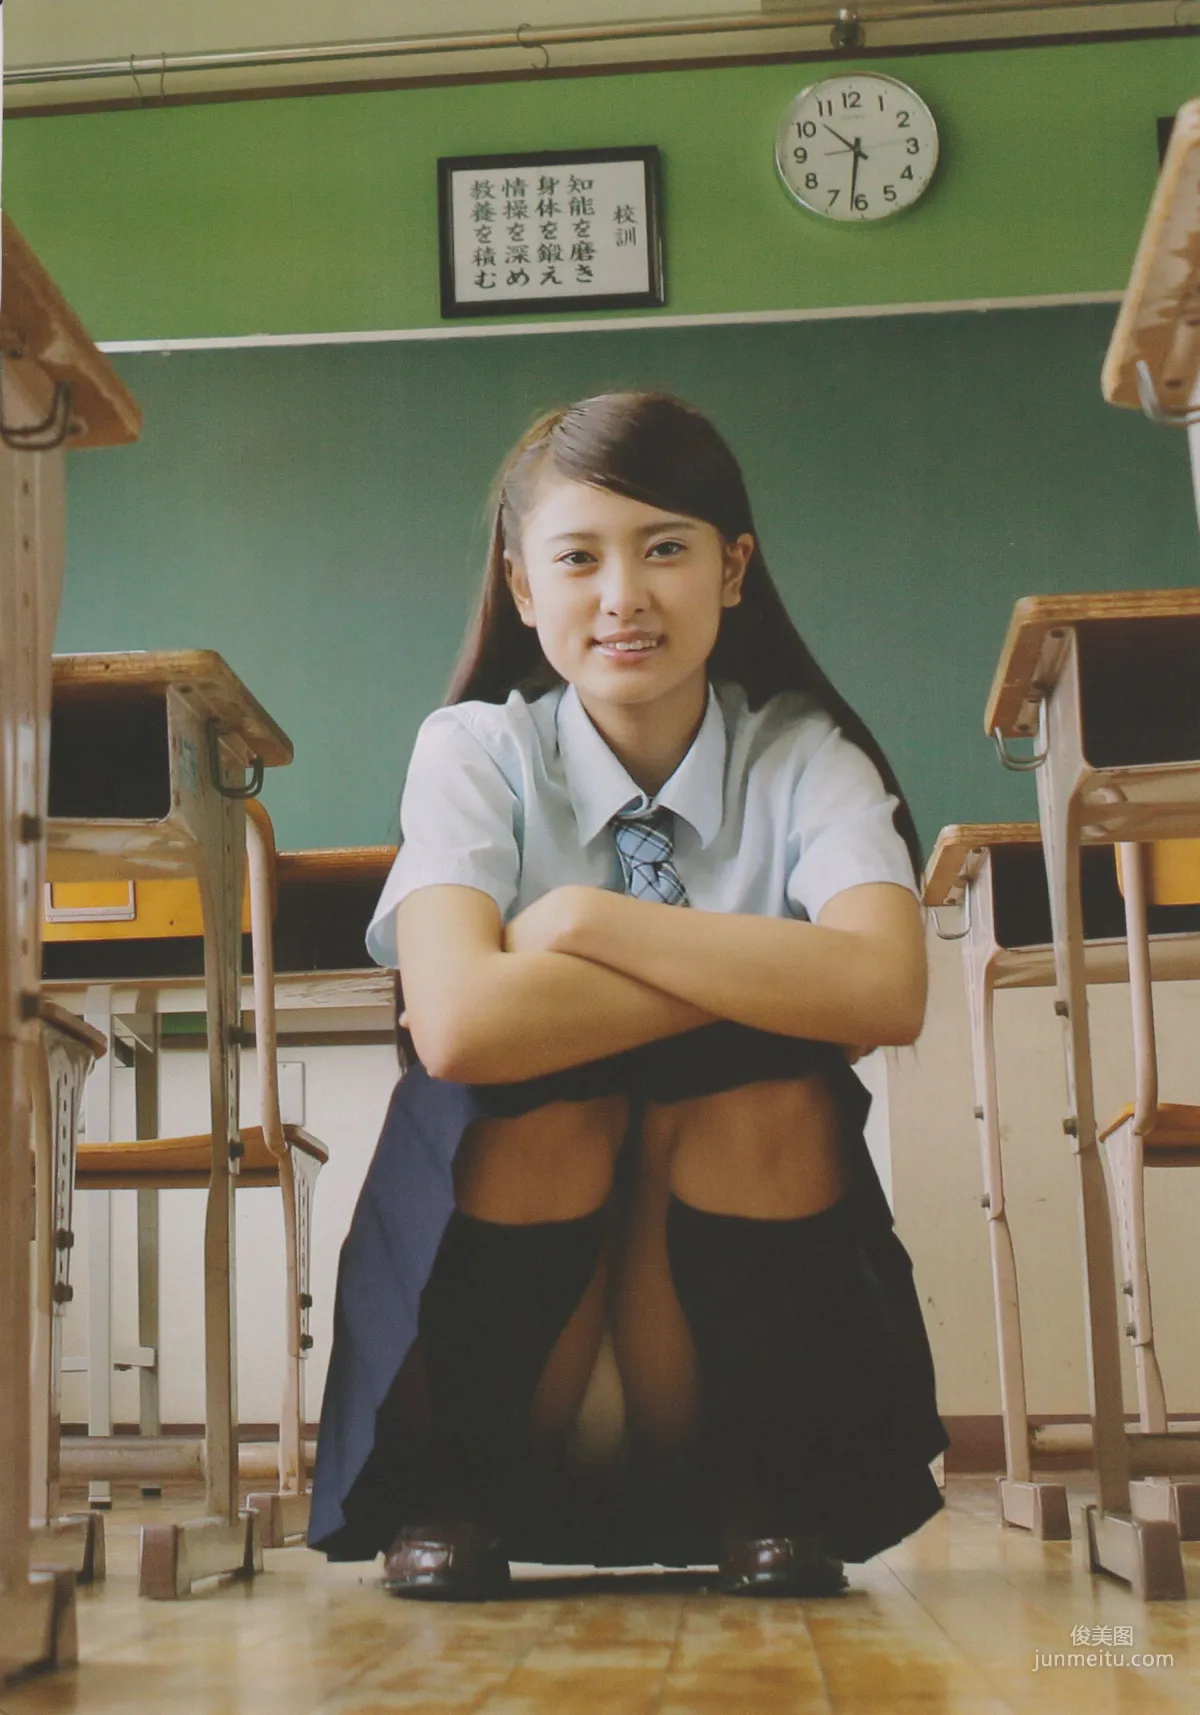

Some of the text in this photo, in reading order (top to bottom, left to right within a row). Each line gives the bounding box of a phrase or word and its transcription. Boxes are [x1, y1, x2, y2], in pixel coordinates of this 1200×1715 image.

[817, 100, 832, 117] 11
[841, 91, 861, 109] 12
[878, 95, 884, 112] 1
[896, 111, 910, 128] 2
[796, 121, 817, 138] 10
[906, 137, 920, 155] 3
[794, 147, 808, 164] 9
[805, 172, 819, 189] 8
[900, 164, 914, 181] 4
[827, 189, 840, 206] 7
[883, 185, 897, 201] 5
[854, 194, 869, 211] 6
[470, 179, 498, 289] 教養を積む
[501, 177, 531, 286] 情操を深め
[535, 175, 564, 285] 身体を鍛え
[567, 174, 596, 283] 知能を磨き
[612, 204, 637, 248] 校訓
